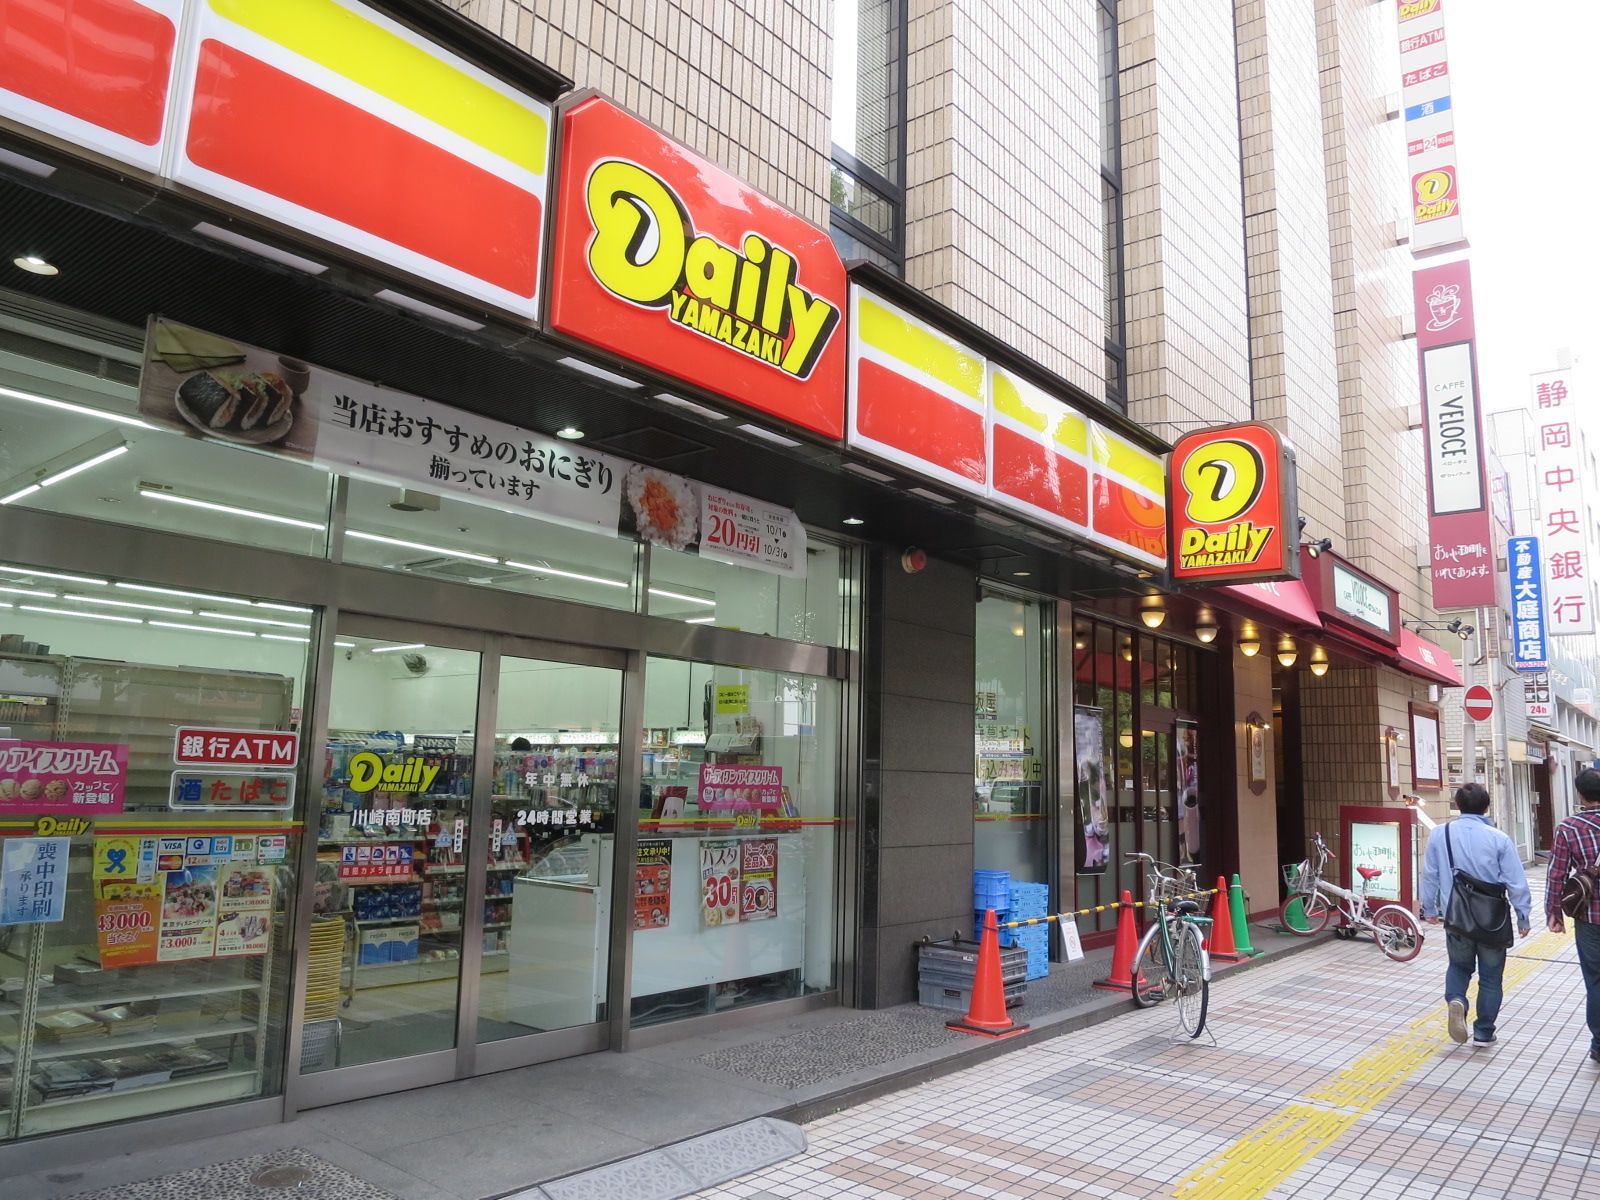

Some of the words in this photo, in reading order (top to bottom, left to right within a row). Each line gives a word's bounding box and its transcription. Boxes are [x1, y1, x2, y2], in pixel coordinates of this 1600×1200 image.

[1401, 29, 1443, 52] 銀行ATM
[1404, 64, 1446, 86] たばこ
[1421, 103, 1434, 117] 酒
[587, 160, 838, 377] Daily
[670, 289, 783, 367] YAMAZAKI
[1439, 395, 1467, 458] VELOCE
[331, 394, 613, 494] 当店おすすめのおにぎり
[429, 454, 541, 500] 揃っています
[1537, 380, 1585, 624] 静岡中央銀行
[1181, 522, 1273, 562] Daily
[1182, 550, 1247, 568] YAMAZAKI
[1515, 541, 1542, 660] 不動産大庭商店
[182, 736, 292, 761] 銀行ATM
[350, 752, 440, 793] Daily
[525, 773, 590, 787] 年中無休
[75, 780, 111, 791] カップで
[177, 778, 203, 802] 酒
[211, 780, 288, 802] たばこ
[378, 783, 418, 792] YAMAZAKI
[38, 816, 90, 836] Daily
[352, 809, 431, 827] 川崎南町店
[517, 809, 592, 826] 24時間営業
[164, 842, 182, 850] VISA
[703, 847, 738, 866] パスタ
[744, 843, 775, 856] ドーナツ
[32, 842, 57, 917] 喪中印刷
[17, 870, 32, 916] 承ります
